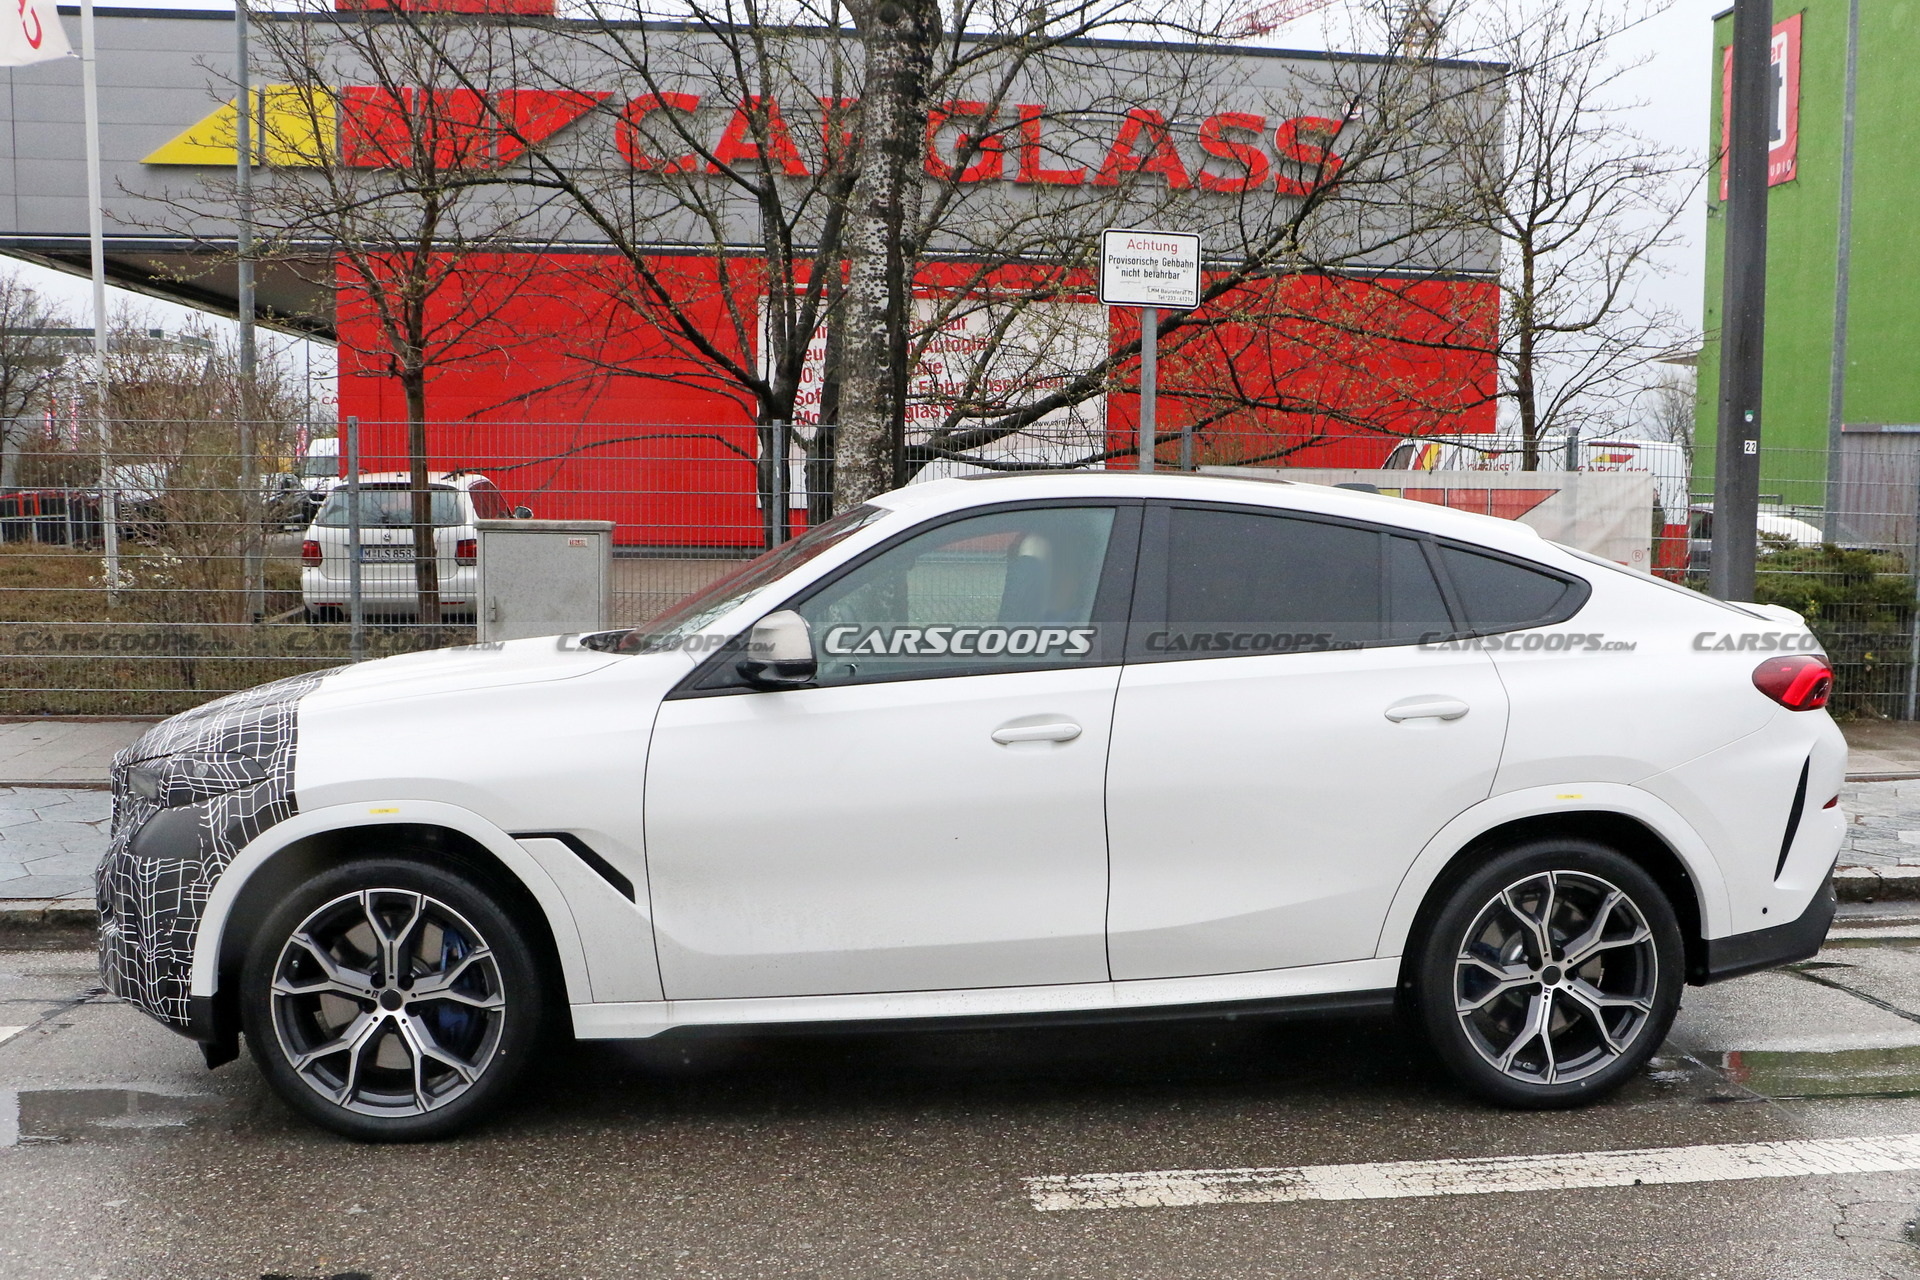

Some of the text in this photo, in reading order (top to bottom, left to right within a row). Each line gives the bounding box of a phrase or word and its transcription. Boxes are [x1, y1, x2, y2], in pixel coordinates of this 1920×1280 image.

[1127, 239, 1178, 254] Achtung
[1108, 254, 1194, 269] Provisorische Gehbahn
[1121, 268, 1181, 281] nicht befahrbar
[1745, 442, 1756, 452] 22
